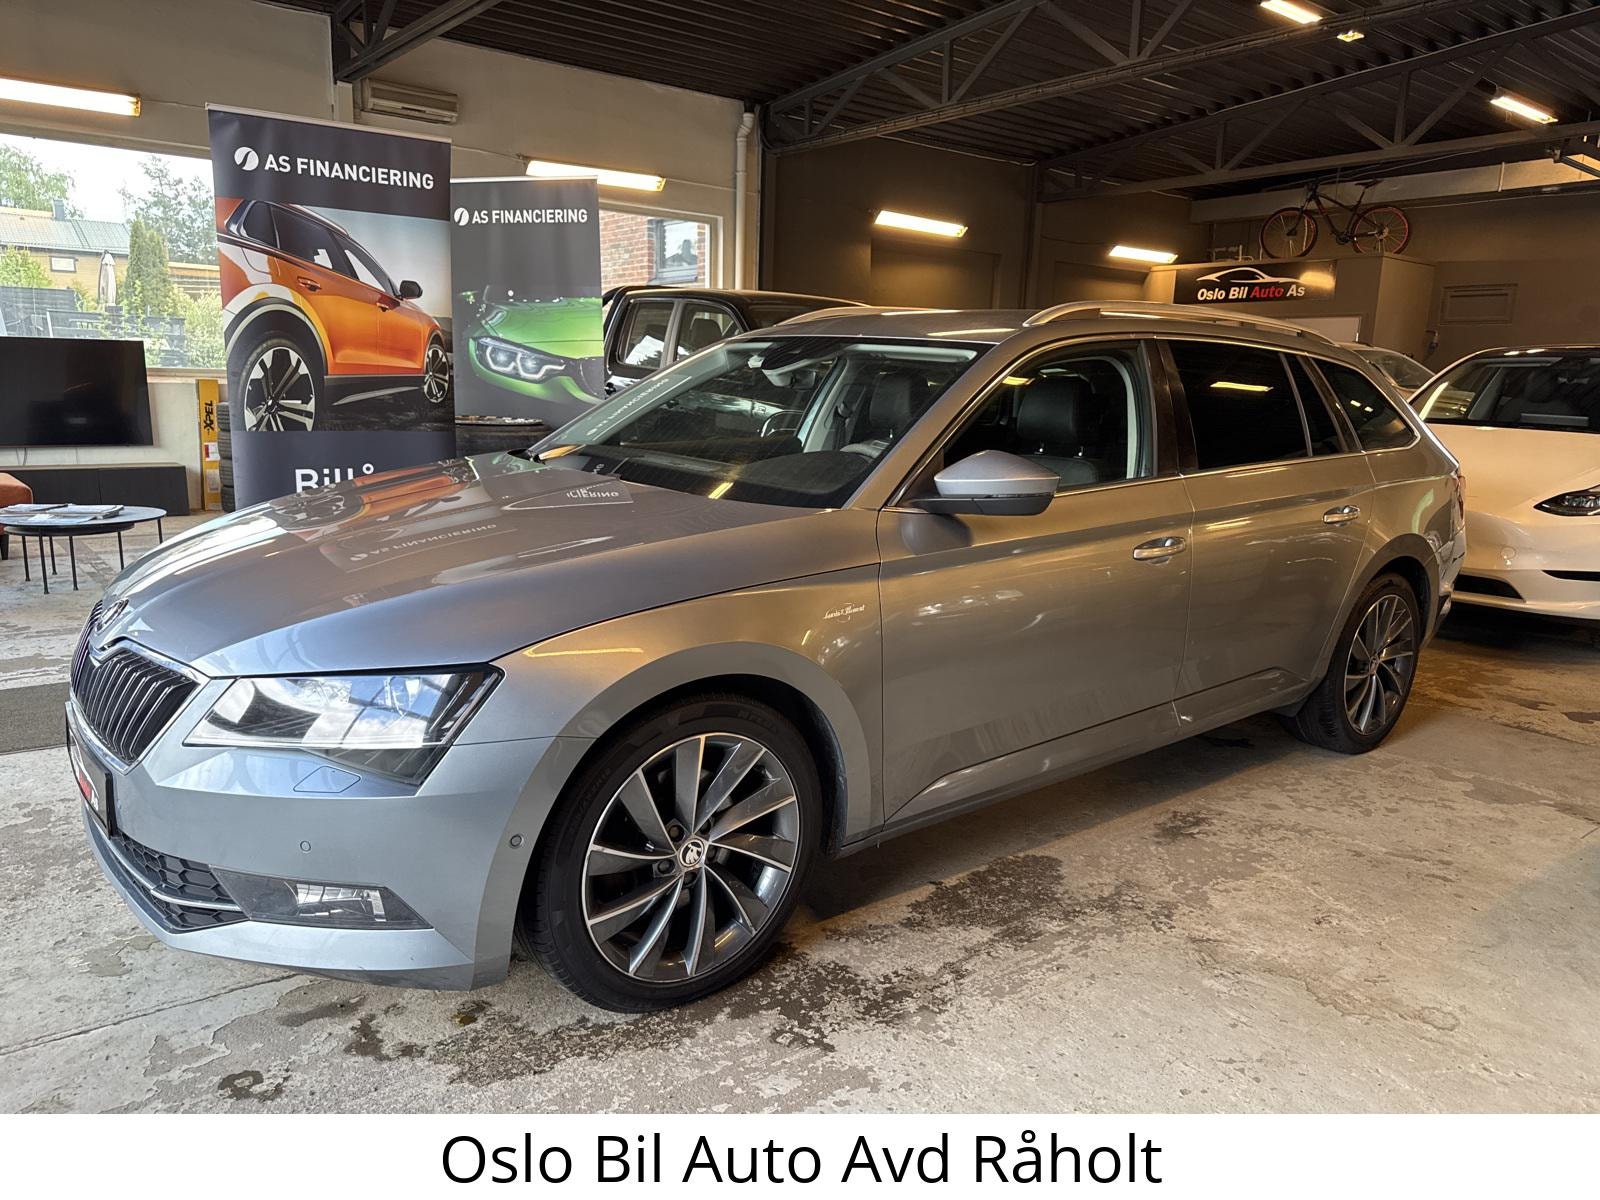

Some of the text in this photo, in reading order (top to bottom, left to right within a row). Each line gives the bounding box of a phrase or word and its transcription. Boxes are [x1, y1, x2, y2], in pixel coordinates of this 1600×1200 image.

[264, 153, 434, 190] AS FINANCIERING
[472, 208, 588, 224] AS FINANCIERING
[1197, 284, 1306, 301] Oslo Bil Auto As
[203, 400, 215, 431] XPEL
